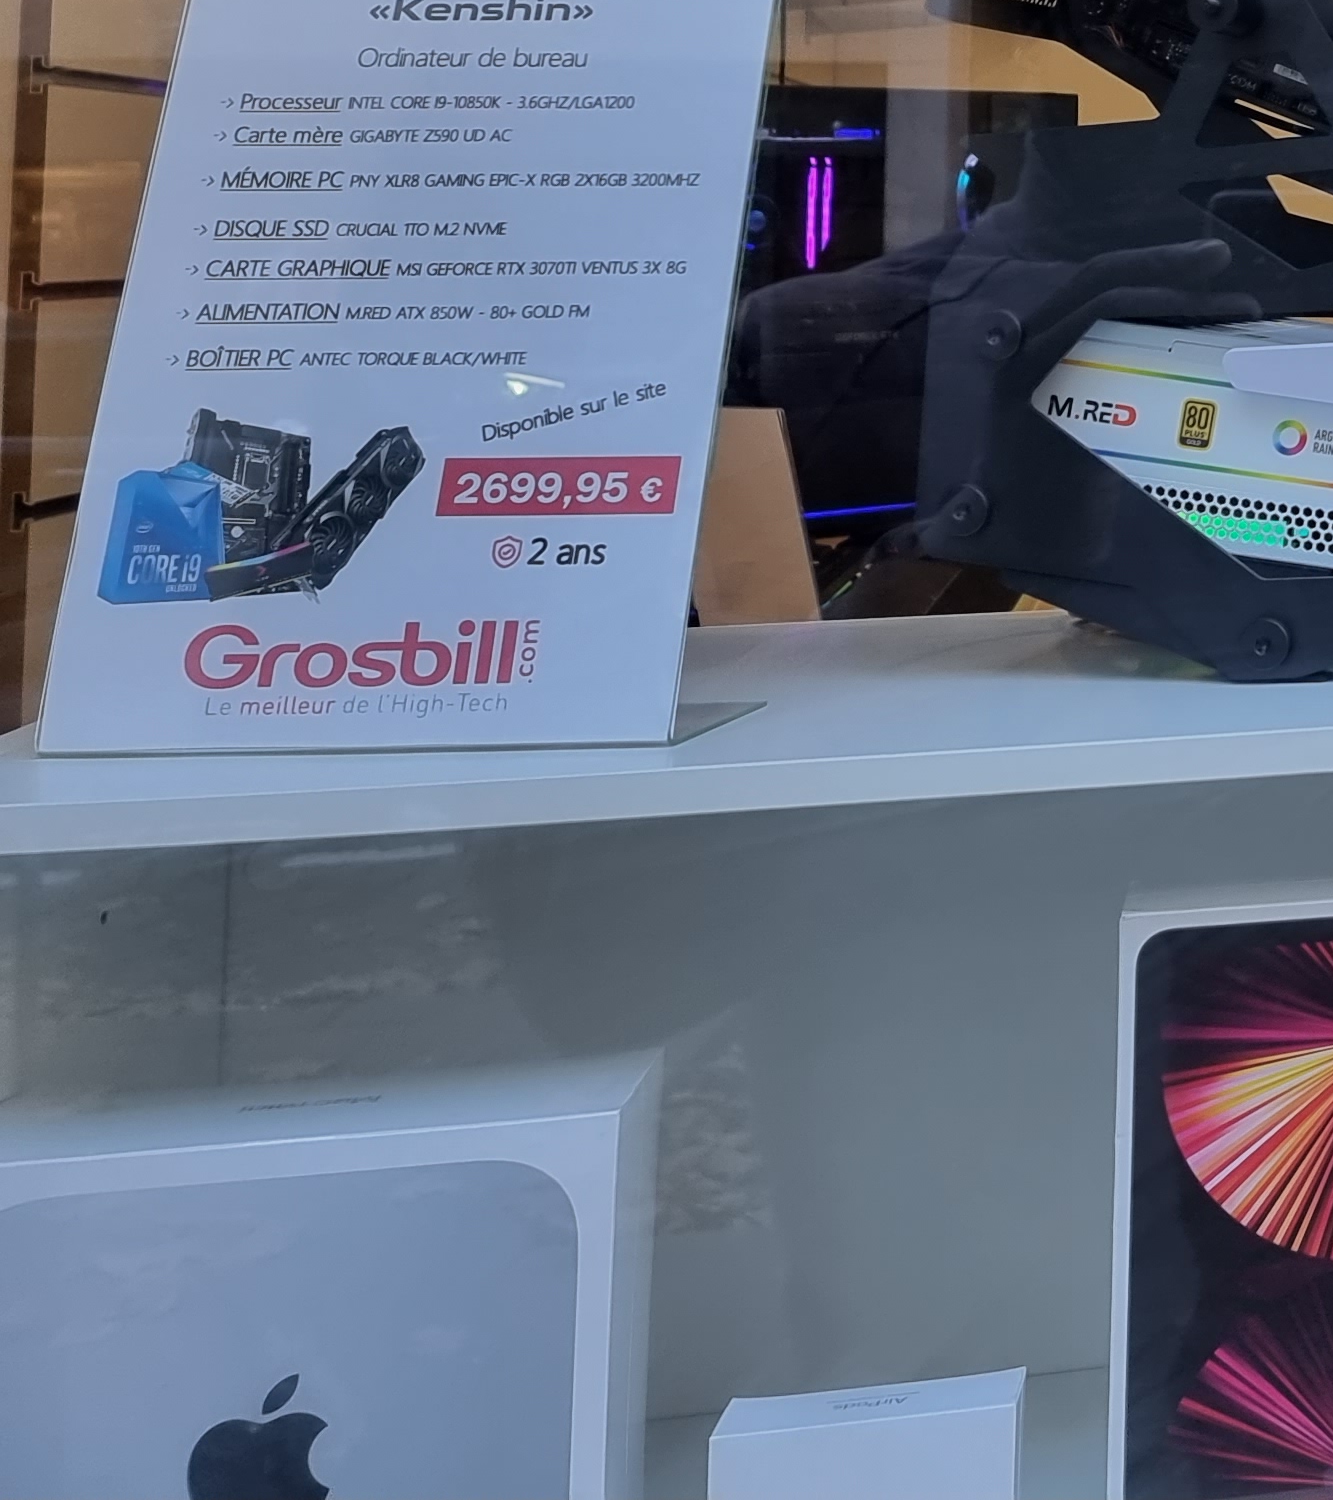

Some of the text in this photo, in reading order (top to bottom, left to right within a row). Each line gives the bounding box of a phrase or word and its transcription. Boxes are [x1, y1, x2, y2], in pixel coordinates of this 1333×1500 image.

[357, 47, 589, 68] Ordinateur de bureau
[239, 93, 344, 111] Processeur
[348, 96, 386, 110] INTEL
[390, 96, 431, 110] CORE
[434, 95, 502, 110] I9-10850K
[233, 126, 513, 144] Carte mère GIGABYTE Z590 UD AC
[220, 166, 700, 189] MÉMOIRE PC PNY XLR8 GAMING EPIC-X RGB 2X16GB 3200MHZ
[213, 219, 288, 238] DISQUE
[292, 219, 329, 237] SSD
[336, 223, 399, 237] CRUCIAL
[463, 222, 509, 236] NVME
[205, 258, 688, 279] CARTE GRAPHIQUE MSI GEFORCE RTX 3070TI VENTUS 3X 8G
[481, 381, 668, 442] Disponible sur le site
[1047, 395, 1138, 427] M.RED
[1185, 405, 1210, 430] 80
[453, 470, 663, 510] 2699,95 €
[527, 537, 607, 565] 2 ans
[127, 553, 202, 584] CORE i9
[184, 619, 520, 689] Grosbill
[204, 693, 508, 719] Le meilleur de l'High-Tech
